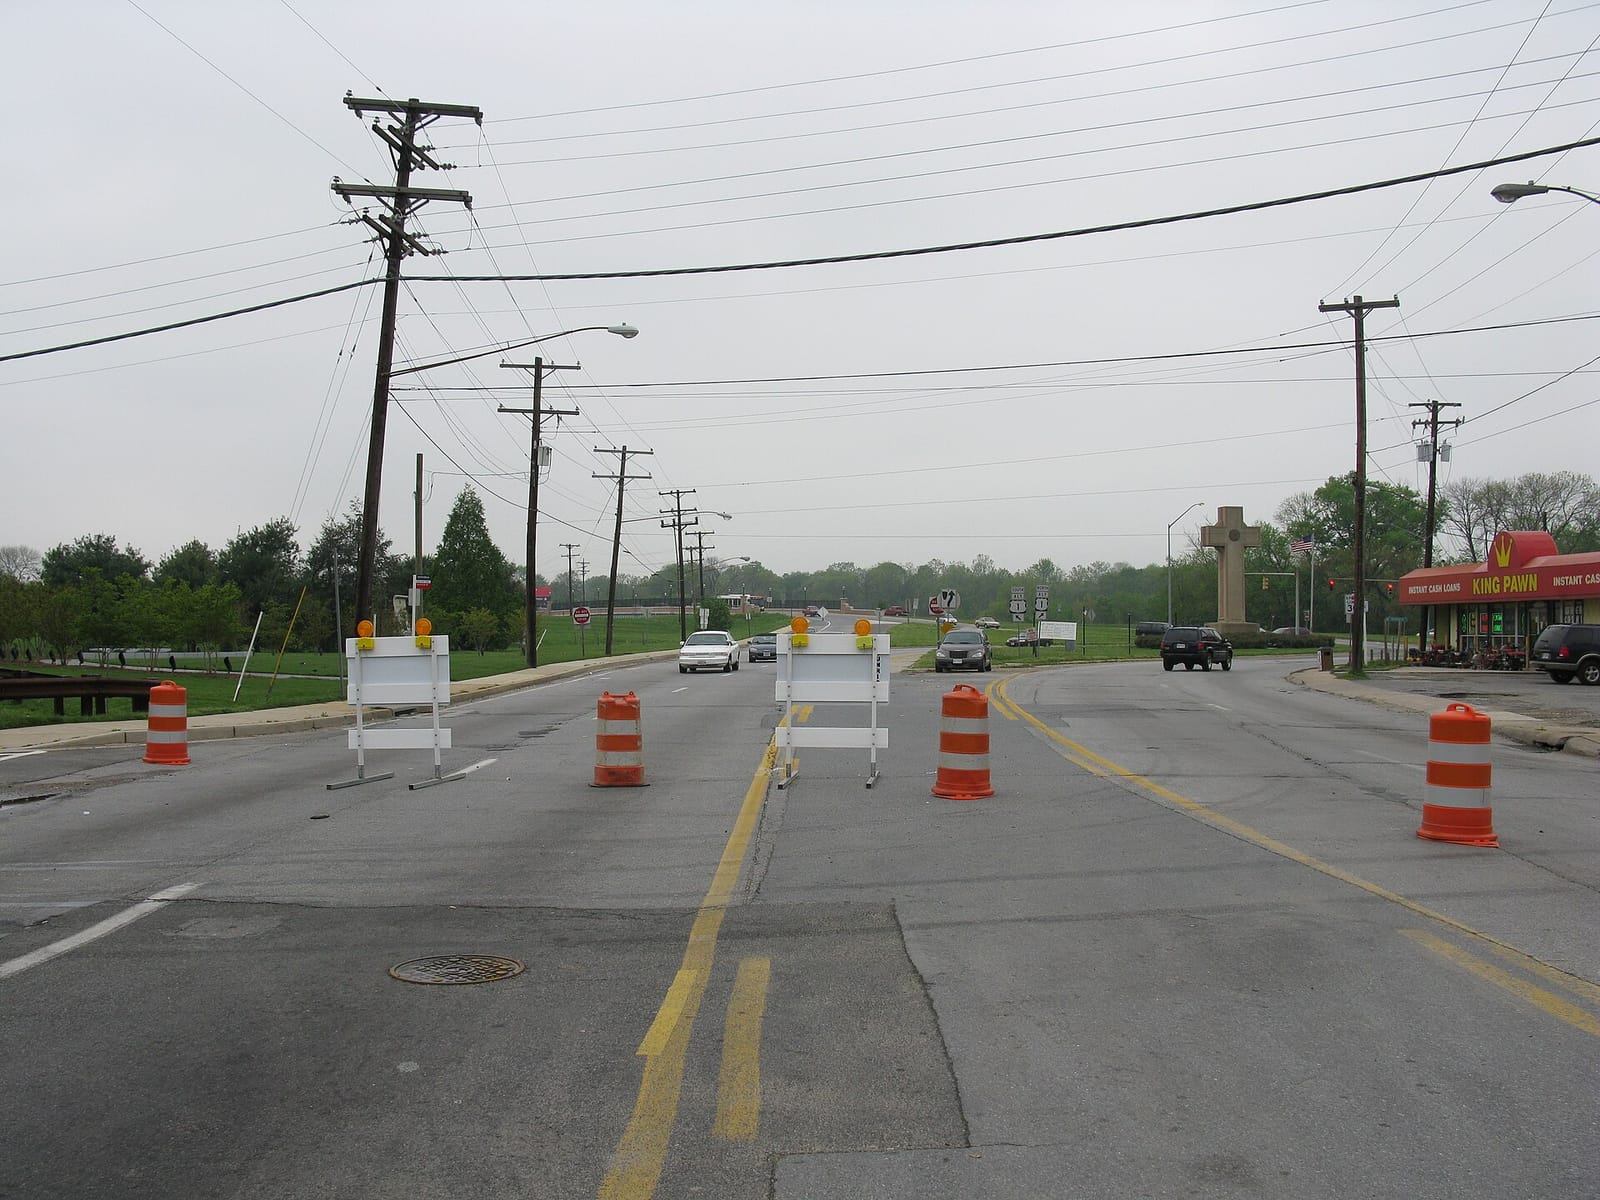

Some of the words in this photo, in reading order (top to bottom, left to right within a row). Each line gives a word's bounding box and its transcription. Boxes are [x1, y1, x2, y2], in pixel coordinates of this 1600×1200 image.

[1472, 576, 1501, 595] KING
[1503, 573, 1538, 593] PAWN
[1553, 575, 1583, 586] INSTANT
[1408, 585, 1428, 595] INSTANT
[1428, 584, 1443, 593] CASH
[1443, 582, 1461, 592] LOANS
